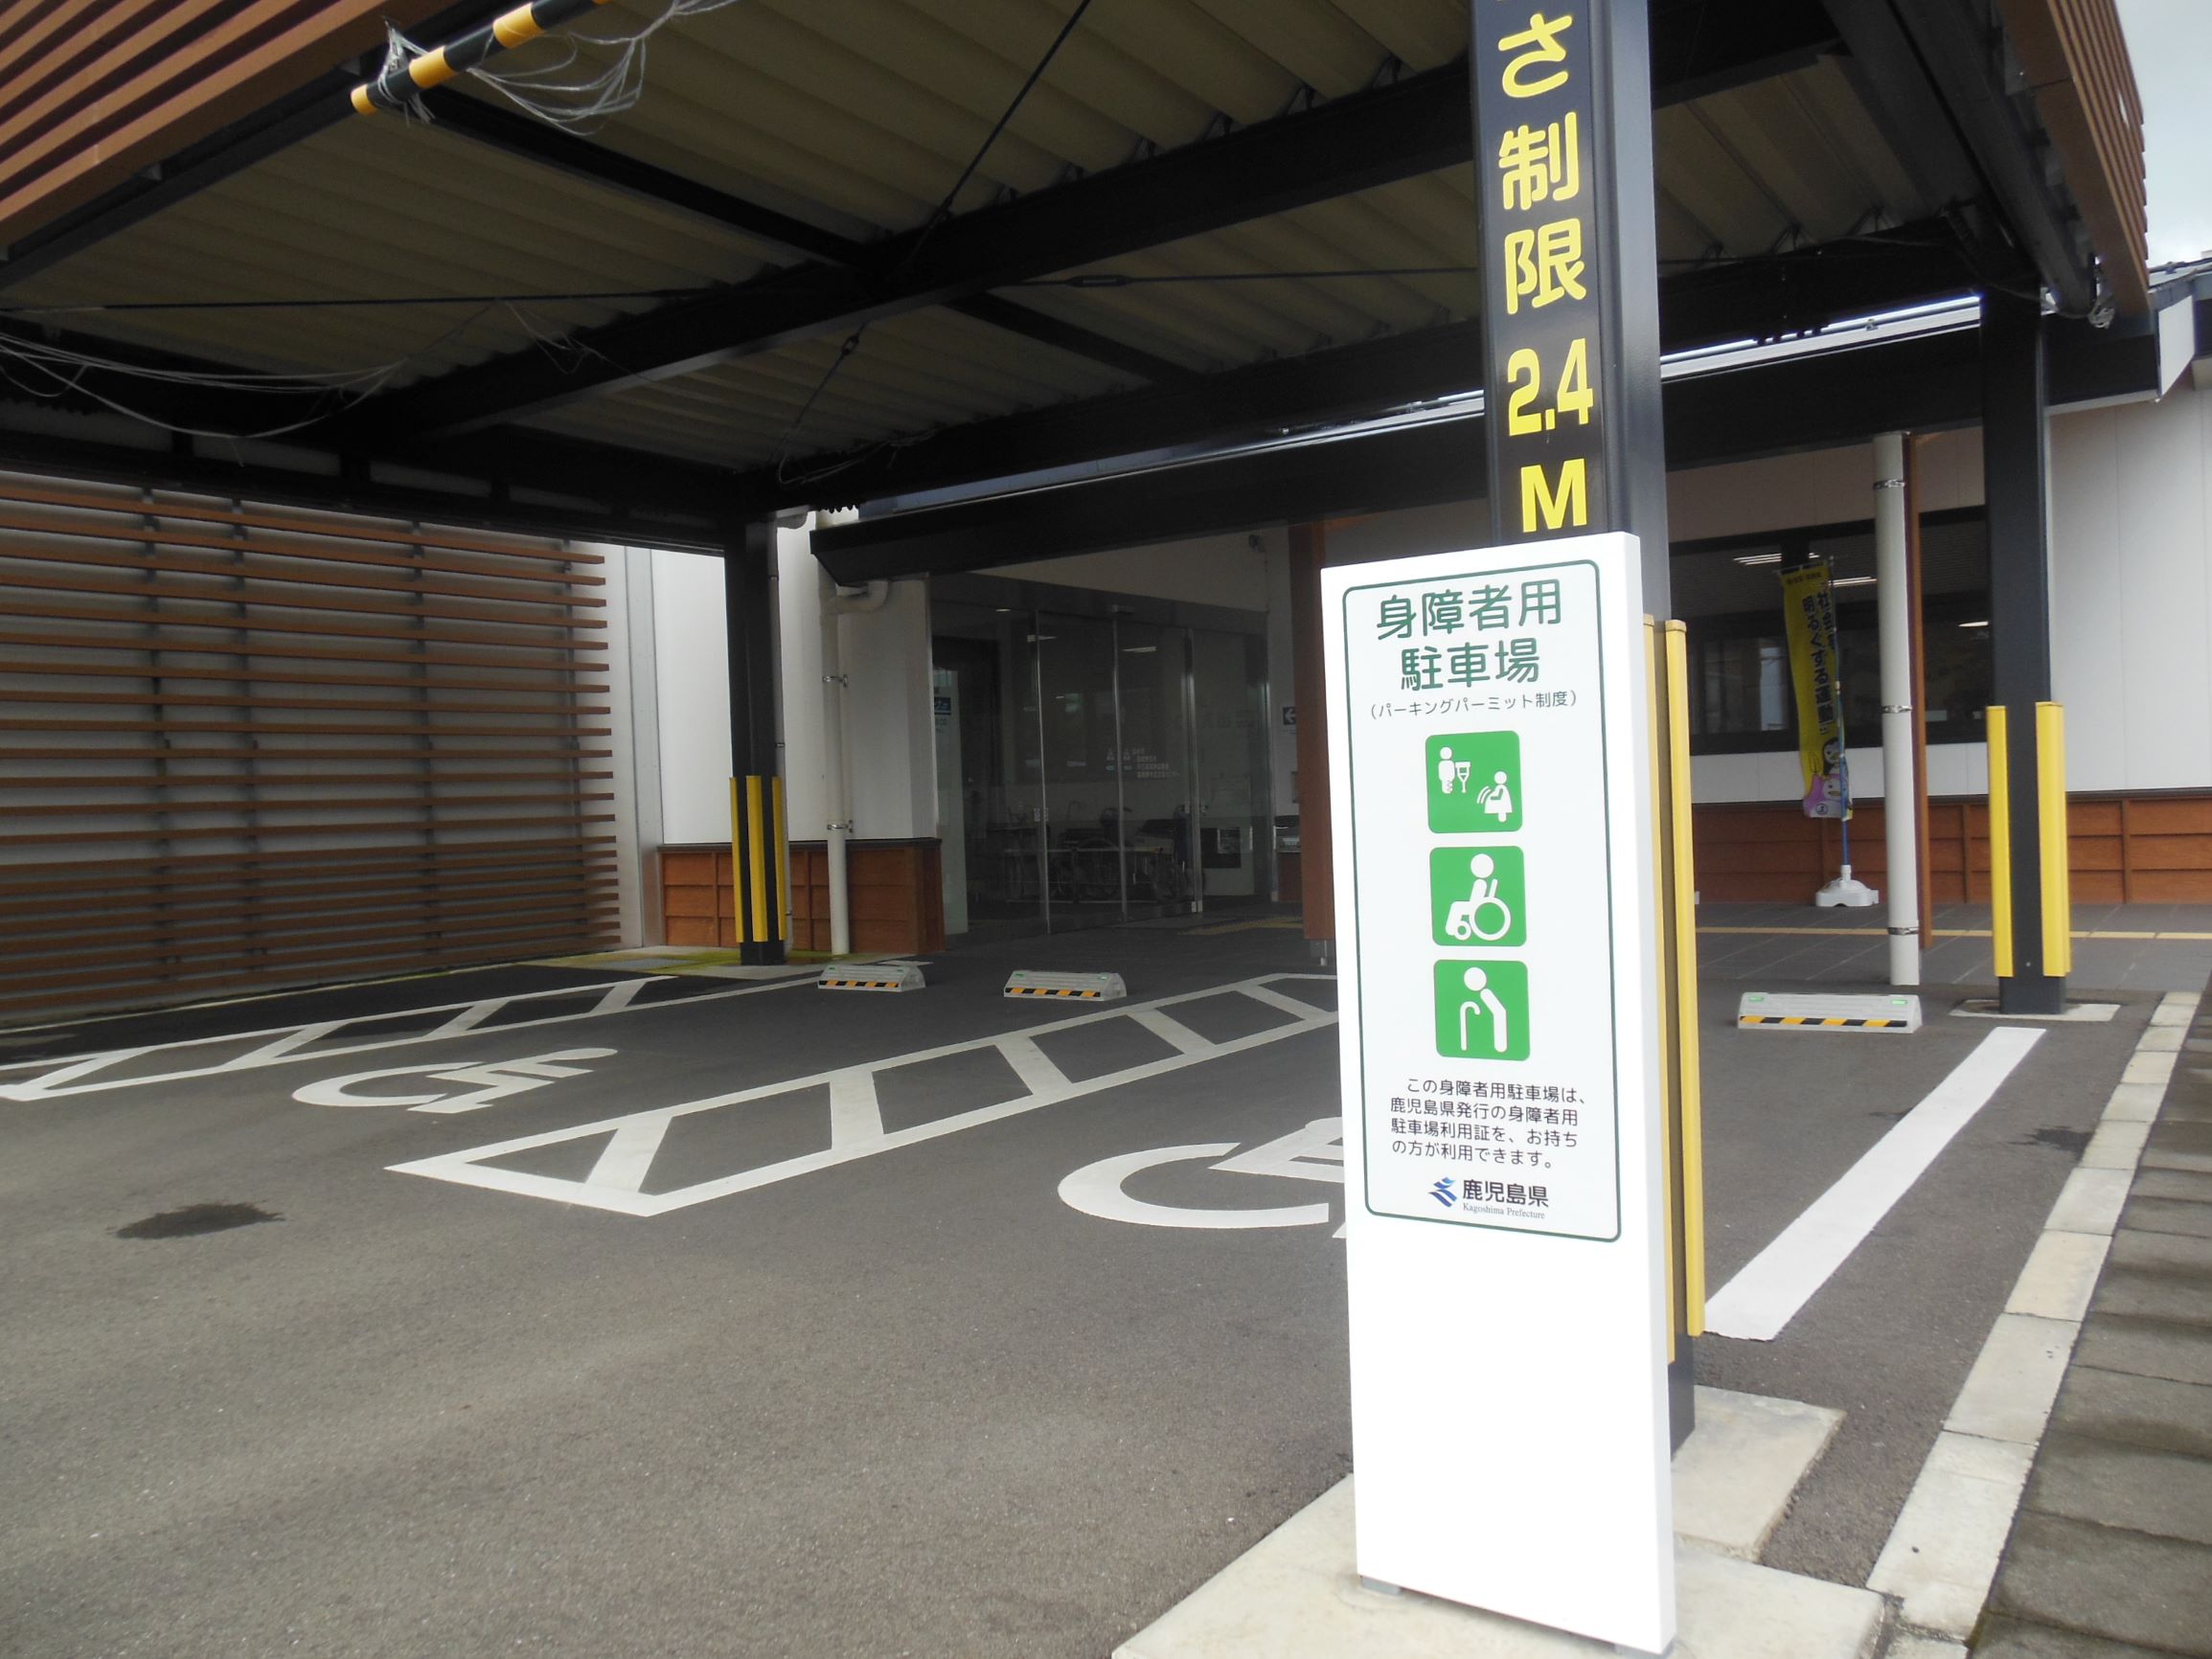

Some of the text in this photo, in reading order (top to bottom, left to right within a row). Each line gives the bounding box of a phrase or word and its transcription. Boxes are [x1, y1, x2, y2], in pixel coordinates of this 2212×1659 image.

[1496, 0, 1594, 533] さ制限2.4M
[1377, 579, 1562, 640] 身障者用
[1401, 637, 1539, 691] 駐車場
[1407, 1078, 1585, 1104] この身障者用駐車場は、
[1390, 1097, 1578, 1126] 鹿児島県発行の身障者用
[1391, 1117, 1578, 1148] 駐車場利用証を、お持ち
[1392, 1140, 1552, 1169] の方が利用できます。
[1463, 1179, 1549, 1207] 鹿児島県
[1463, 1203, 1545, 1219] Kagoshima Prefecture
